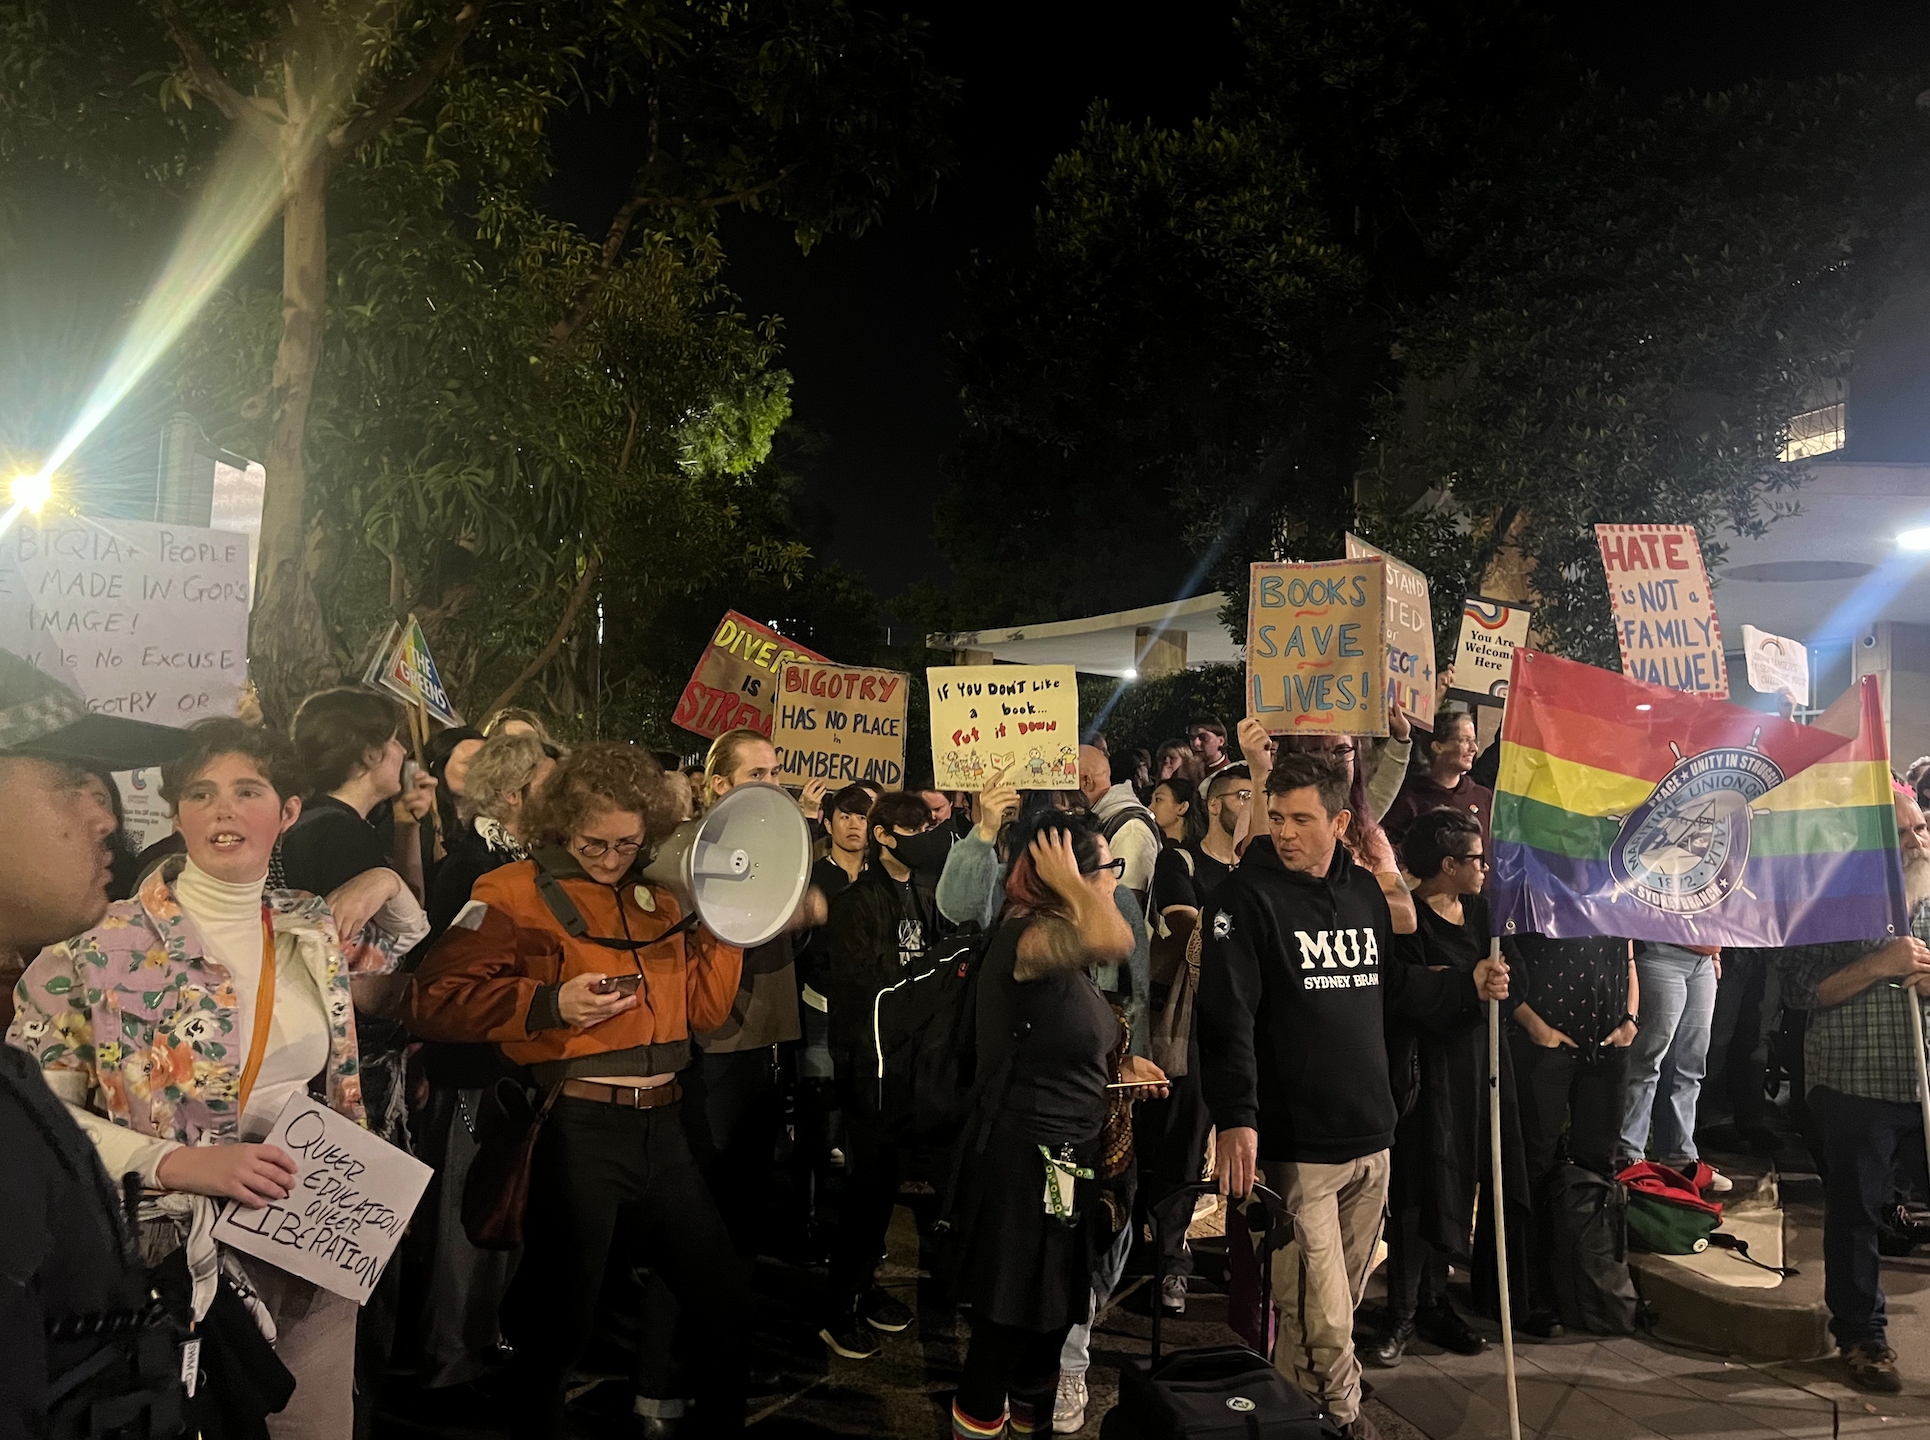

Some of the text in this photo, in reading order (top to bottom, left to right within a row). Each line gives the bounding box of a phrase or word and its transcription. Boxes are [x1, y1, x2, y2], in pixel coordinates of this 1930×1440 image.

[160, 531, 237, 563] PEOPLE
[1602, 534, 1690, 572] HATE
[40, 568, 123, 599] MADE
[143, 574, 173, 601] IN
[182, 575, 248, 603] GOD'S
[1260, 575, 1368, 608] BOOKS
[1385, 563, 1425, 599] STAND
[1619, 579, 1700, 613] is NOT a
[28, 604, 140, 635] IMAGE!
[1386, 595, 1424, 633] TED
[1256, 623, 1365, 659] SAVE
[1386, 629, 1400, 641] or
[1470, 630, 1515, 648] You Are
[1623, 616, 1712, 649] FAMILY
[142, 646, 235, 670] EXCUSE
[409, 645, 433, 679] THE
[1474, 656, 1503, 671] Here
[1629, 649, 1720, 690] VALUE!
[400, 659, 447, 710] GREENS
[741, 675, 762, 697] IS
[784, 666, 899, 703] BIGOTRY
[937, 682, 950, 702] IF
[957, 682, 982, 698] YOU
[987, 680, 1027, 697] DON'T
[1253, 671, 1369, 714] LIVES!
[1386, 677, 1433, 719] ALITY
[177, 692, 211, 712] OR
[969, 708, 978, 719] a
[781, 705, 901, 737] HAS NO PLACE
[994, 721, 1007, 739] it
[833, 733, 841, 744] in
[1648, 775, 1682, 808] PEACE
[1689, 755, 1724, 777] UNITY
[1725, 754, 1738, 768] IN
[1627, 795, 1684, 872] MARITIME
[1689, 775, 1747, 798] UNION
[1745, 785, 1762, 799] OF
[1637, 883, 1723, 910] SYDNEY BRANCH
[1293, 927, 1379, 970] MUA
[1303, 974, 1351, 990] SYDNEY
[284, 1109, 366, 1183] QUEER
[303, 1169, 407, 1239] EDUCATION
[304, 1200, 361, 1236] QUEER
[227, 1201, 388, 1289] LIBERATION
